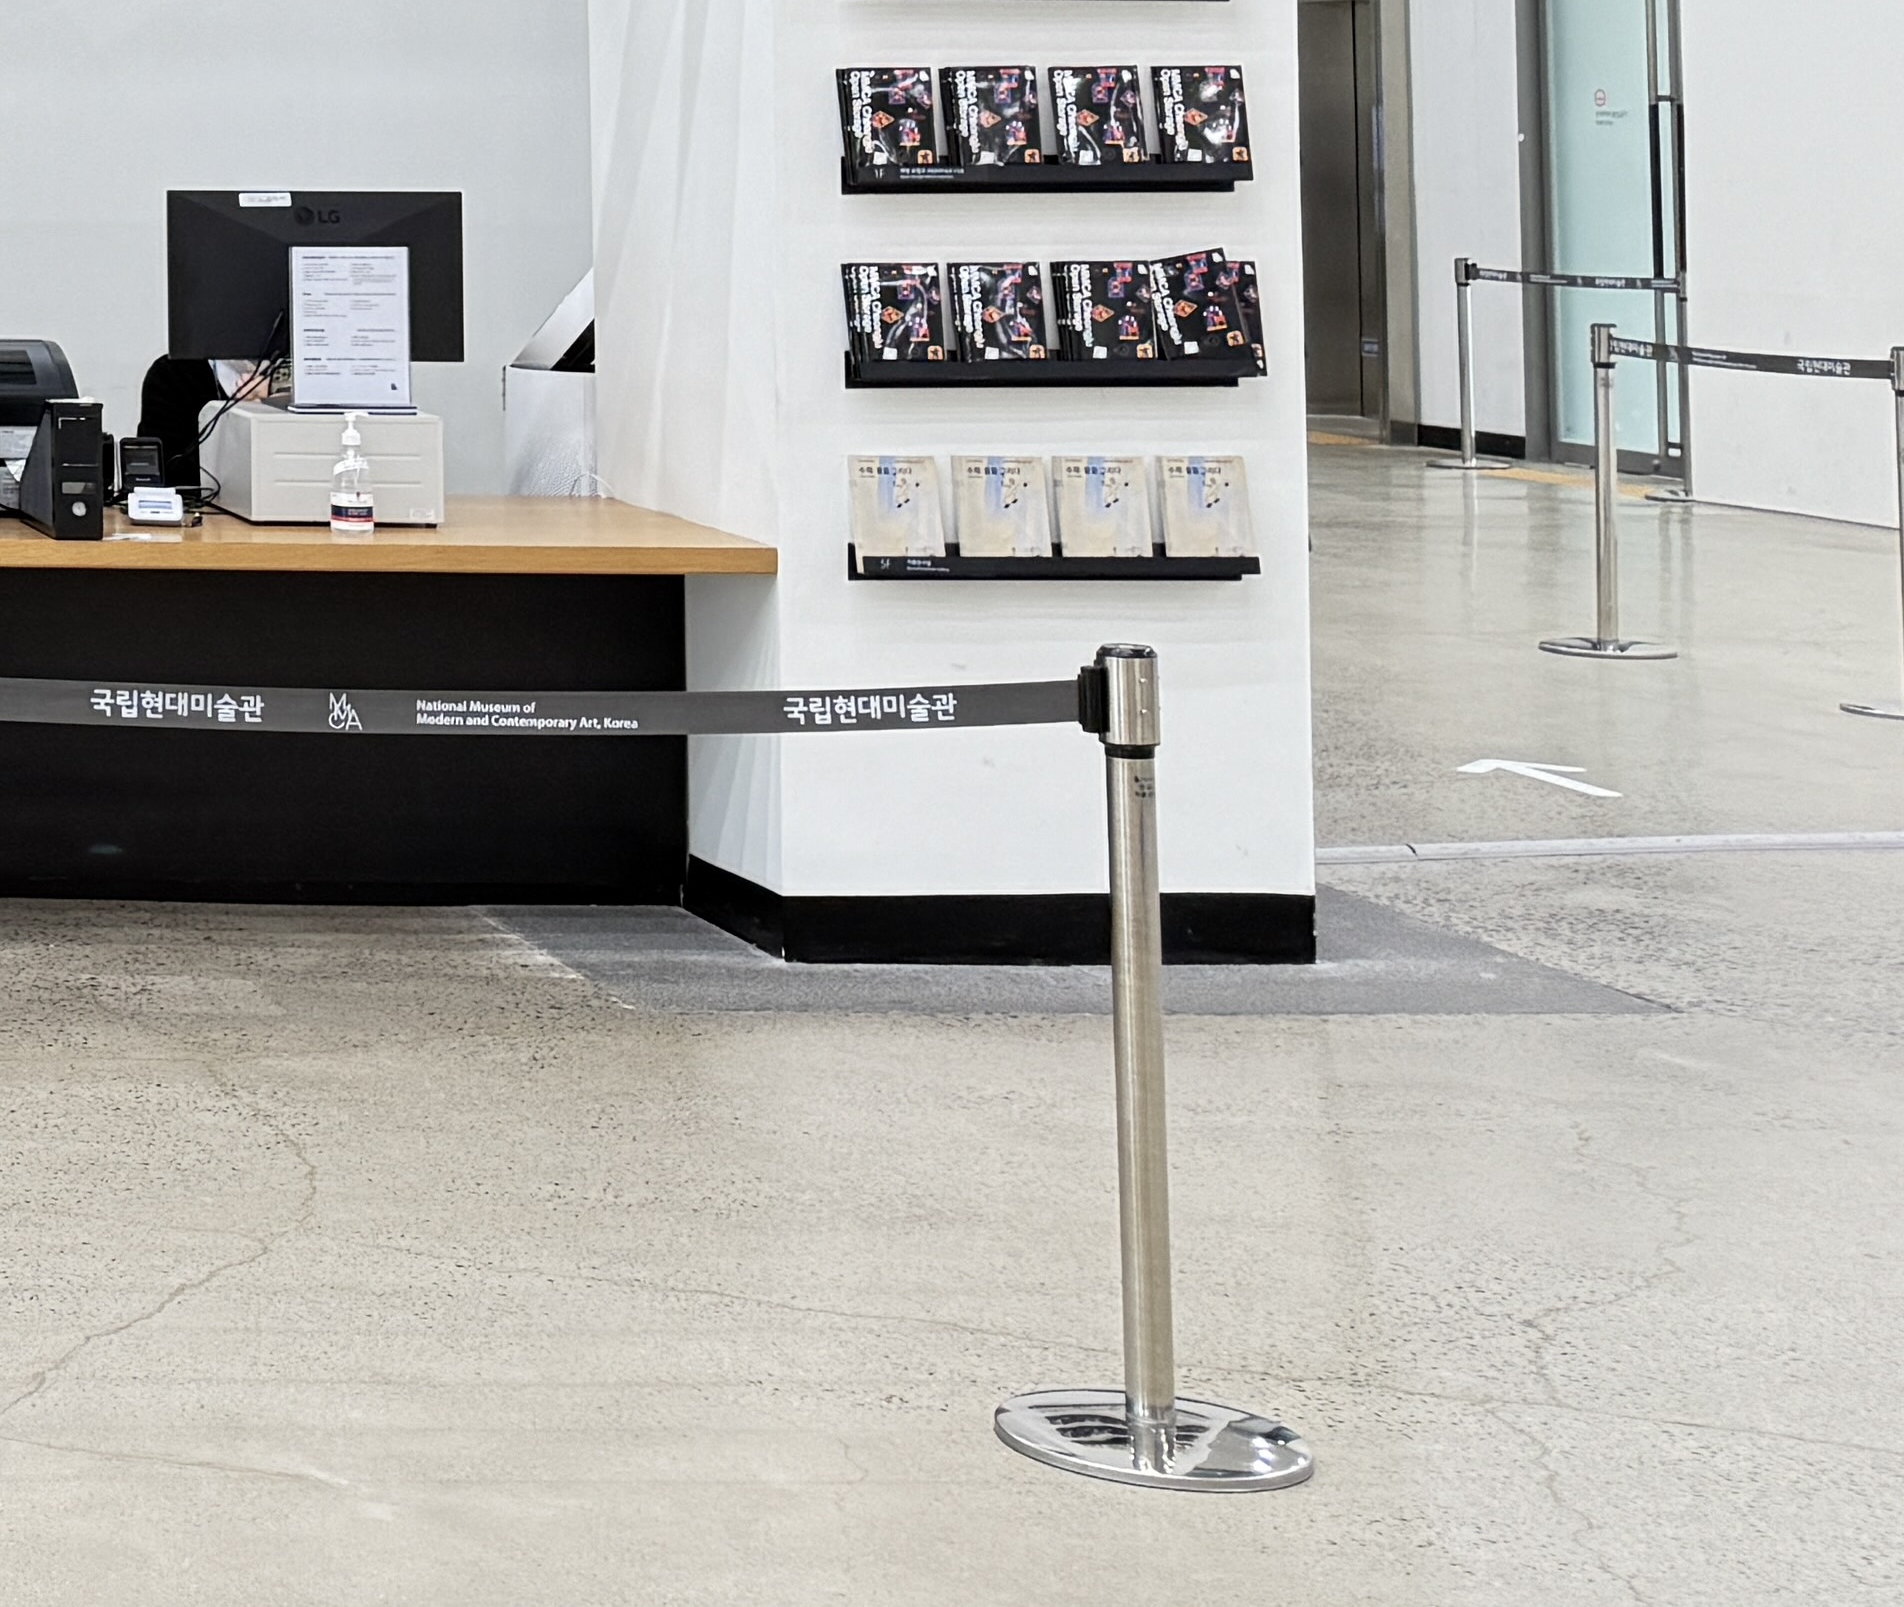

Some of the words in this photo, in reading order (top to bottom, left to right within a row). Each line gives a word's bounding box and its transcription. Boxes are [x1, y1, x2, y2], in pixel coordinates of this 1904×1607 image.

[317, 209, 341, 225] LG
[91, 689, 264, 722] 국립현대미술관
[416, 699, 467, 711] National
[469, 700, 520, 711] Museum
[523, 701, 536, 712] of
[781, 690, 960, 728] 국립현대미술관
[416, 712, 463, 724] Modern
[466, 713, 489, 725] and
[491, 714, 577, 729] Contemporary
[604, 717, 638, 728] Korea
